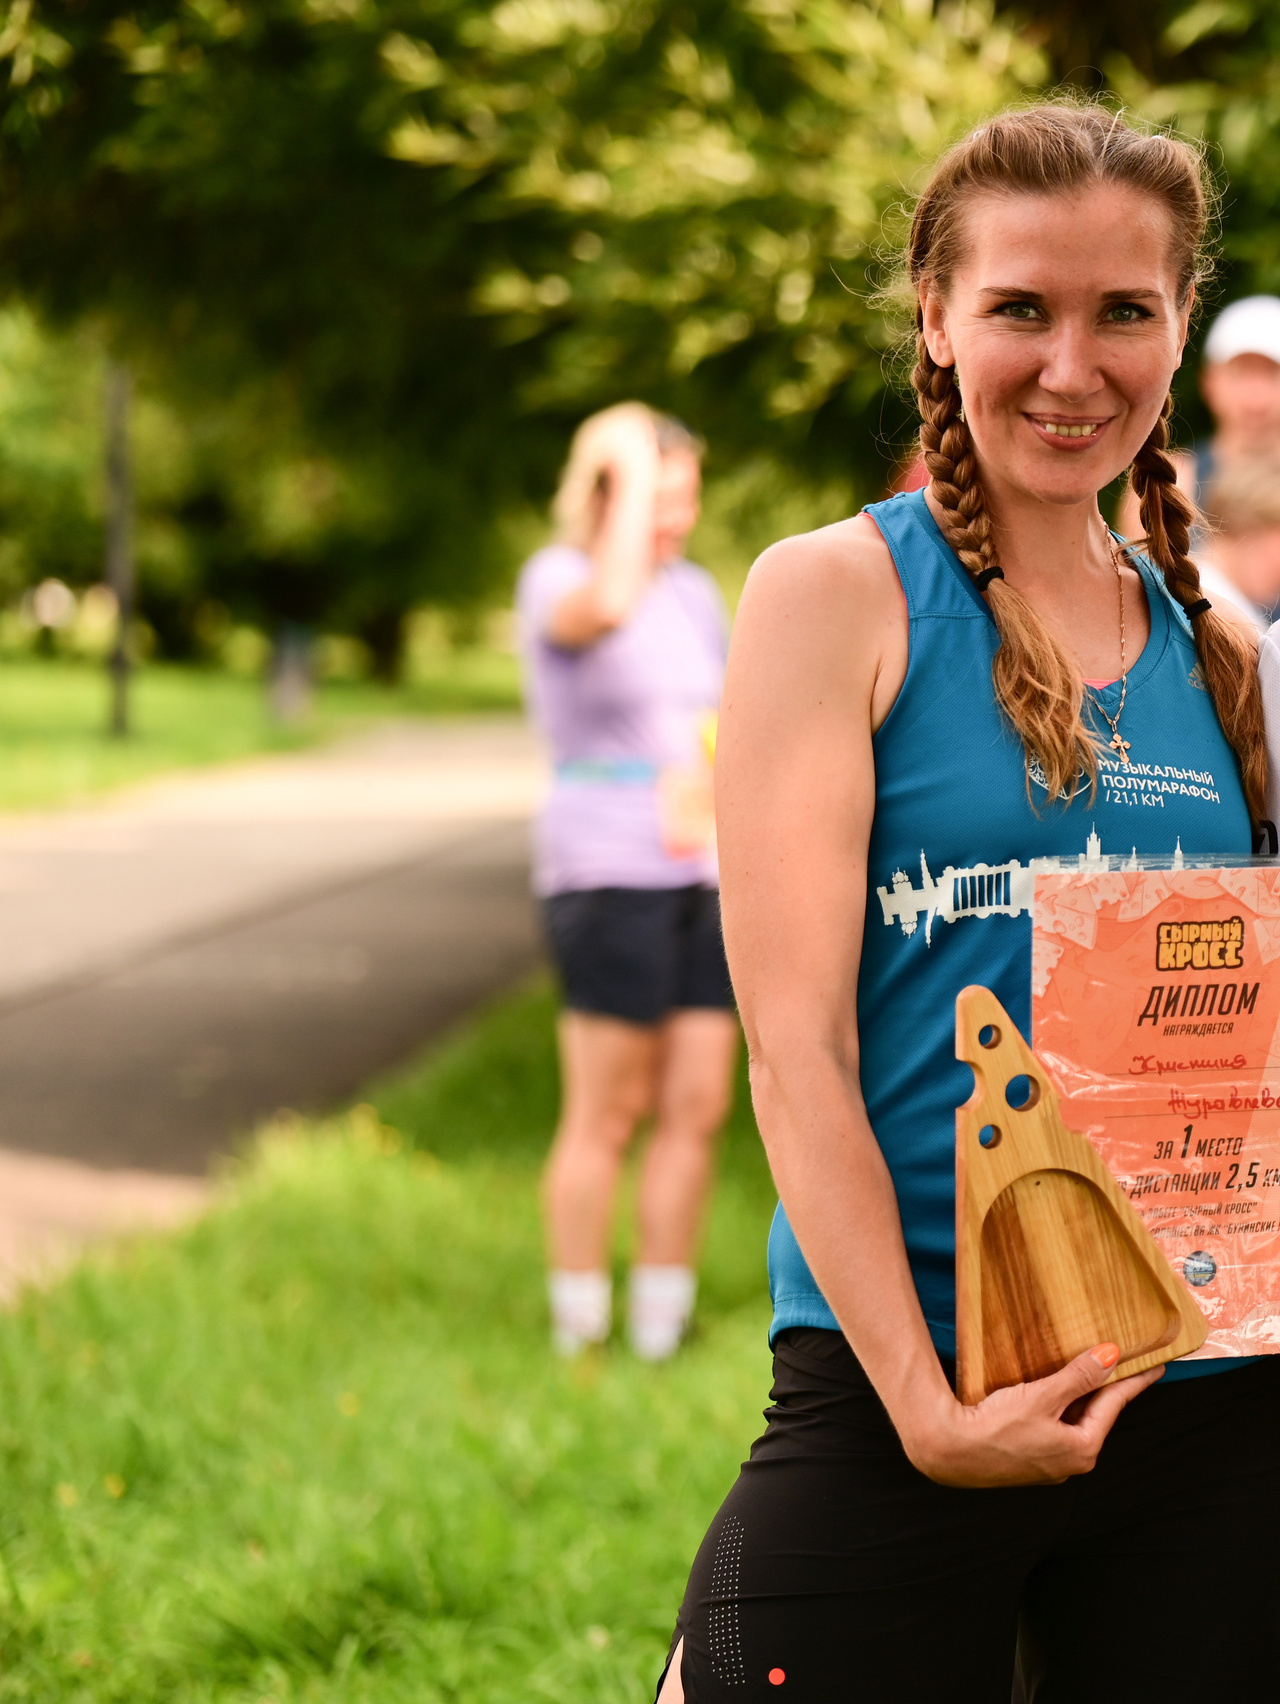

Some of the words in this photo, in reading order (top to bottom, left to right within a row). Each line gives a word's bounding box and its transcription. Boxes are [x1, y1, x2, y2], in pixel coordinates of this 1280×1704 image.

[1097, 758, 1215, 786] МУЗЫКАЛЬНЫЙ
[1101, 774, 1221, 804] ПОЛУМАРАФОН
[1141, 793, 1165, 808] КМ
[1158, 917, 1243, 943] СЫРНЫЙ
[1158, 941, 1242, 969] КРОСС
[1138, 982, 1261, 1027] ДИПЛОМ
[1162, 1022, 1235, 1037] НАГРАЖДАЕТСЯ
[1153, 1140, 1175, 1160] ЗА
[1180, 1123, 1194, 1159] 1
[1194, 1136, 1244, 1158] МЕСТО
[1129, 1171, 1222, 1200] ДИСТАНЦИИ
[1225, 1161, 1261, 1194] 2,5
[1206, 1224, 1221, 1237] ЖК
